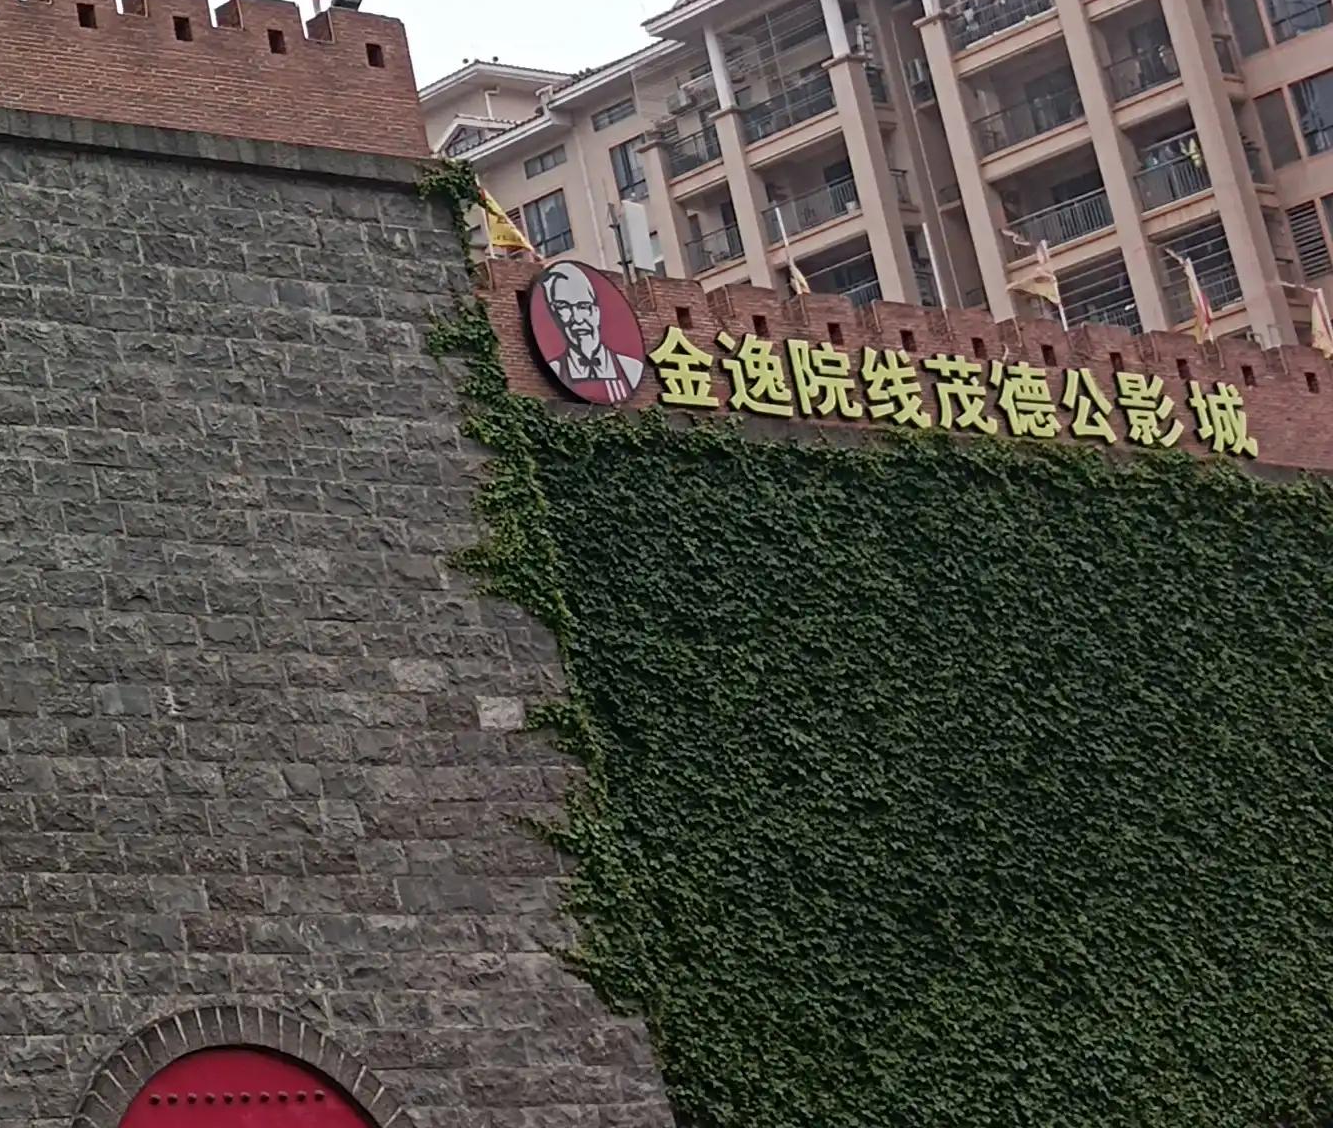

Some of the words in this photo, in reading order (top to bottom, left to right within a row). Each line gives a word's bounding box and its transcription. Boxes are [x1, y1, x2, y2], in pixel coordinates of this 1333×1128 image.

[649, 326, 1259, 456] 金逸院线茂德公影城
